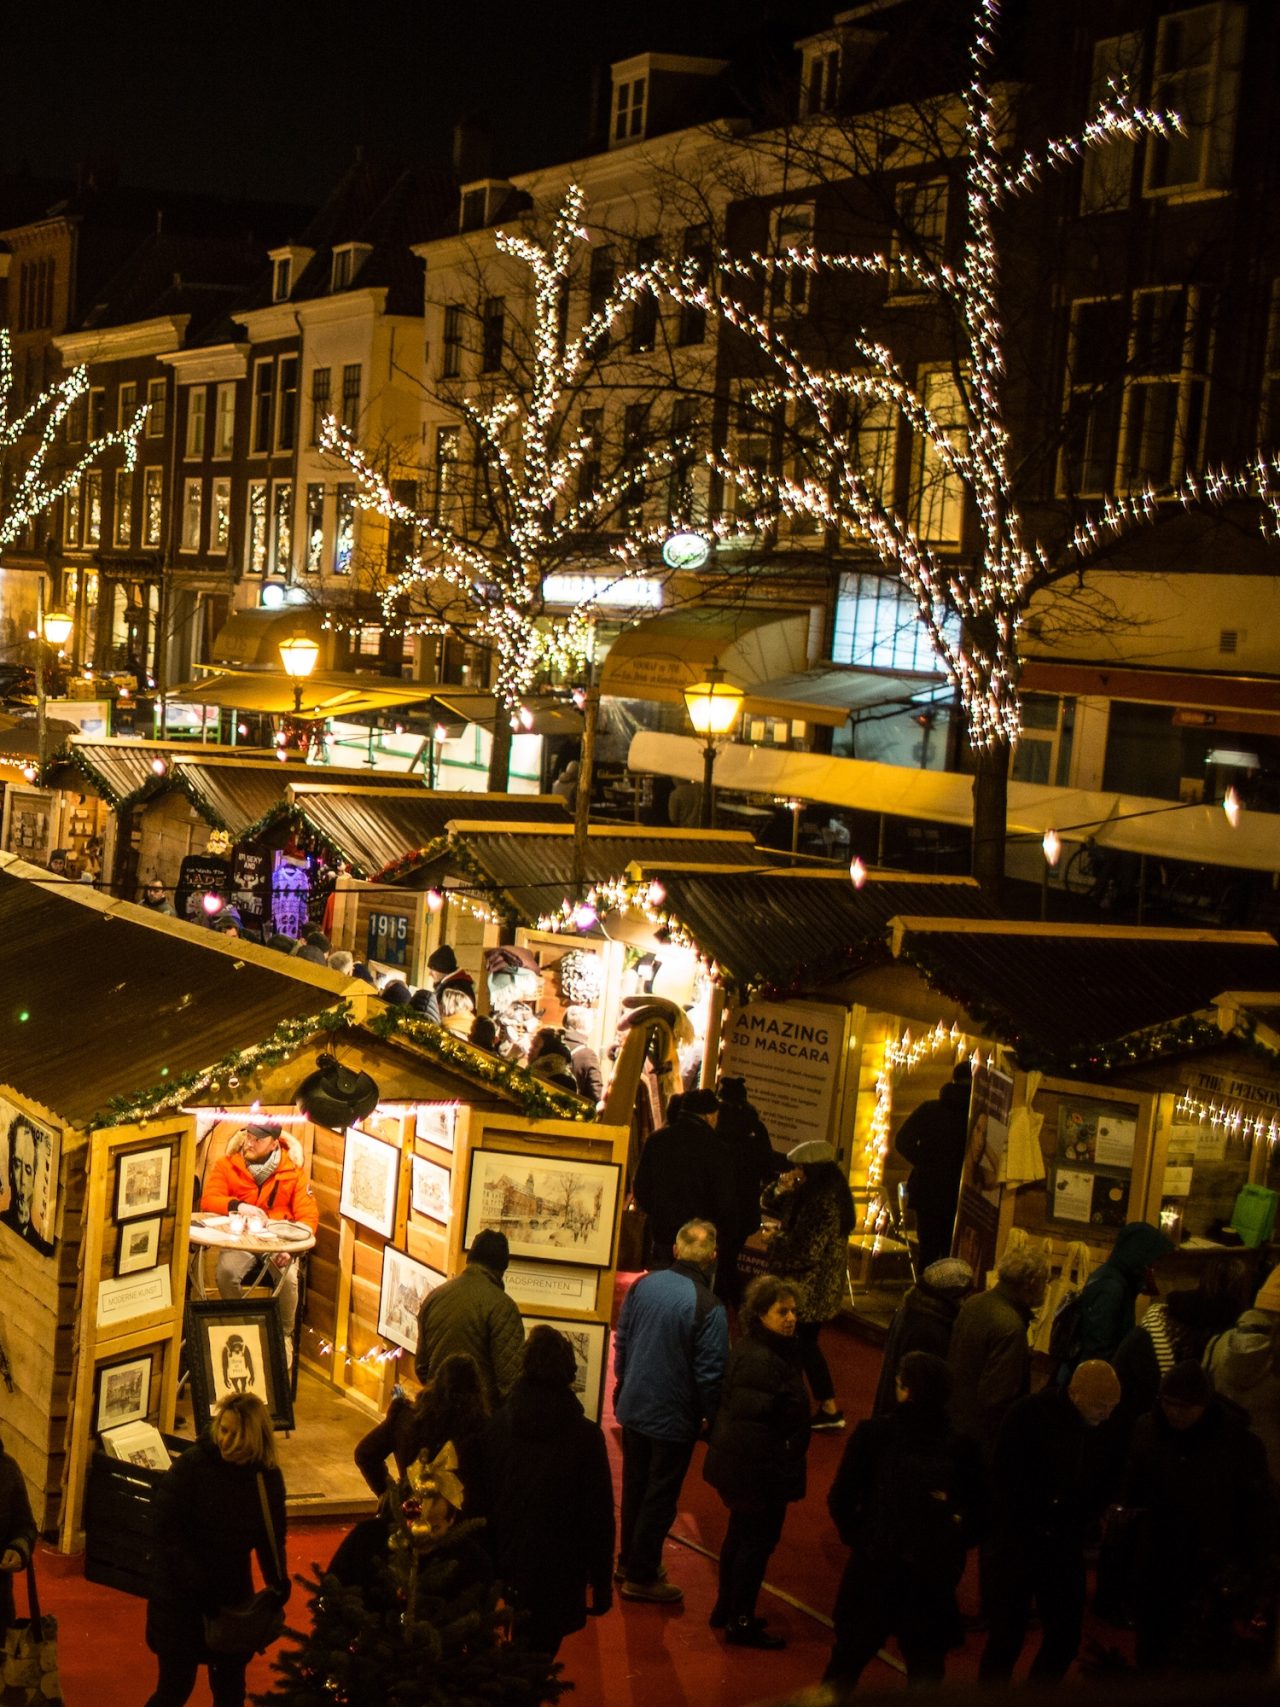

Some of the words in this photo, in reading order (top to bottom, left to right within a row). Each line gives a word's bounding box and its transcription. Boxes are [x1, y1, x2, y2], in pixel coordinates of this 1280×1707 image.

[370, 914, 407, 939] 1915
[736, 1014, 829, 1045] AMAZING
[731, 1032, 750, 1046] 3D
[755, 1037, 830, 1064] MASCARA
[1200, 1073, 1224, 1091] THE
[505, 1276, 570, 1291] TADSPRENTEN
[108, 1291, 137, 1305] MODERNE
[138, 1285, 158, 1298] KUNST
